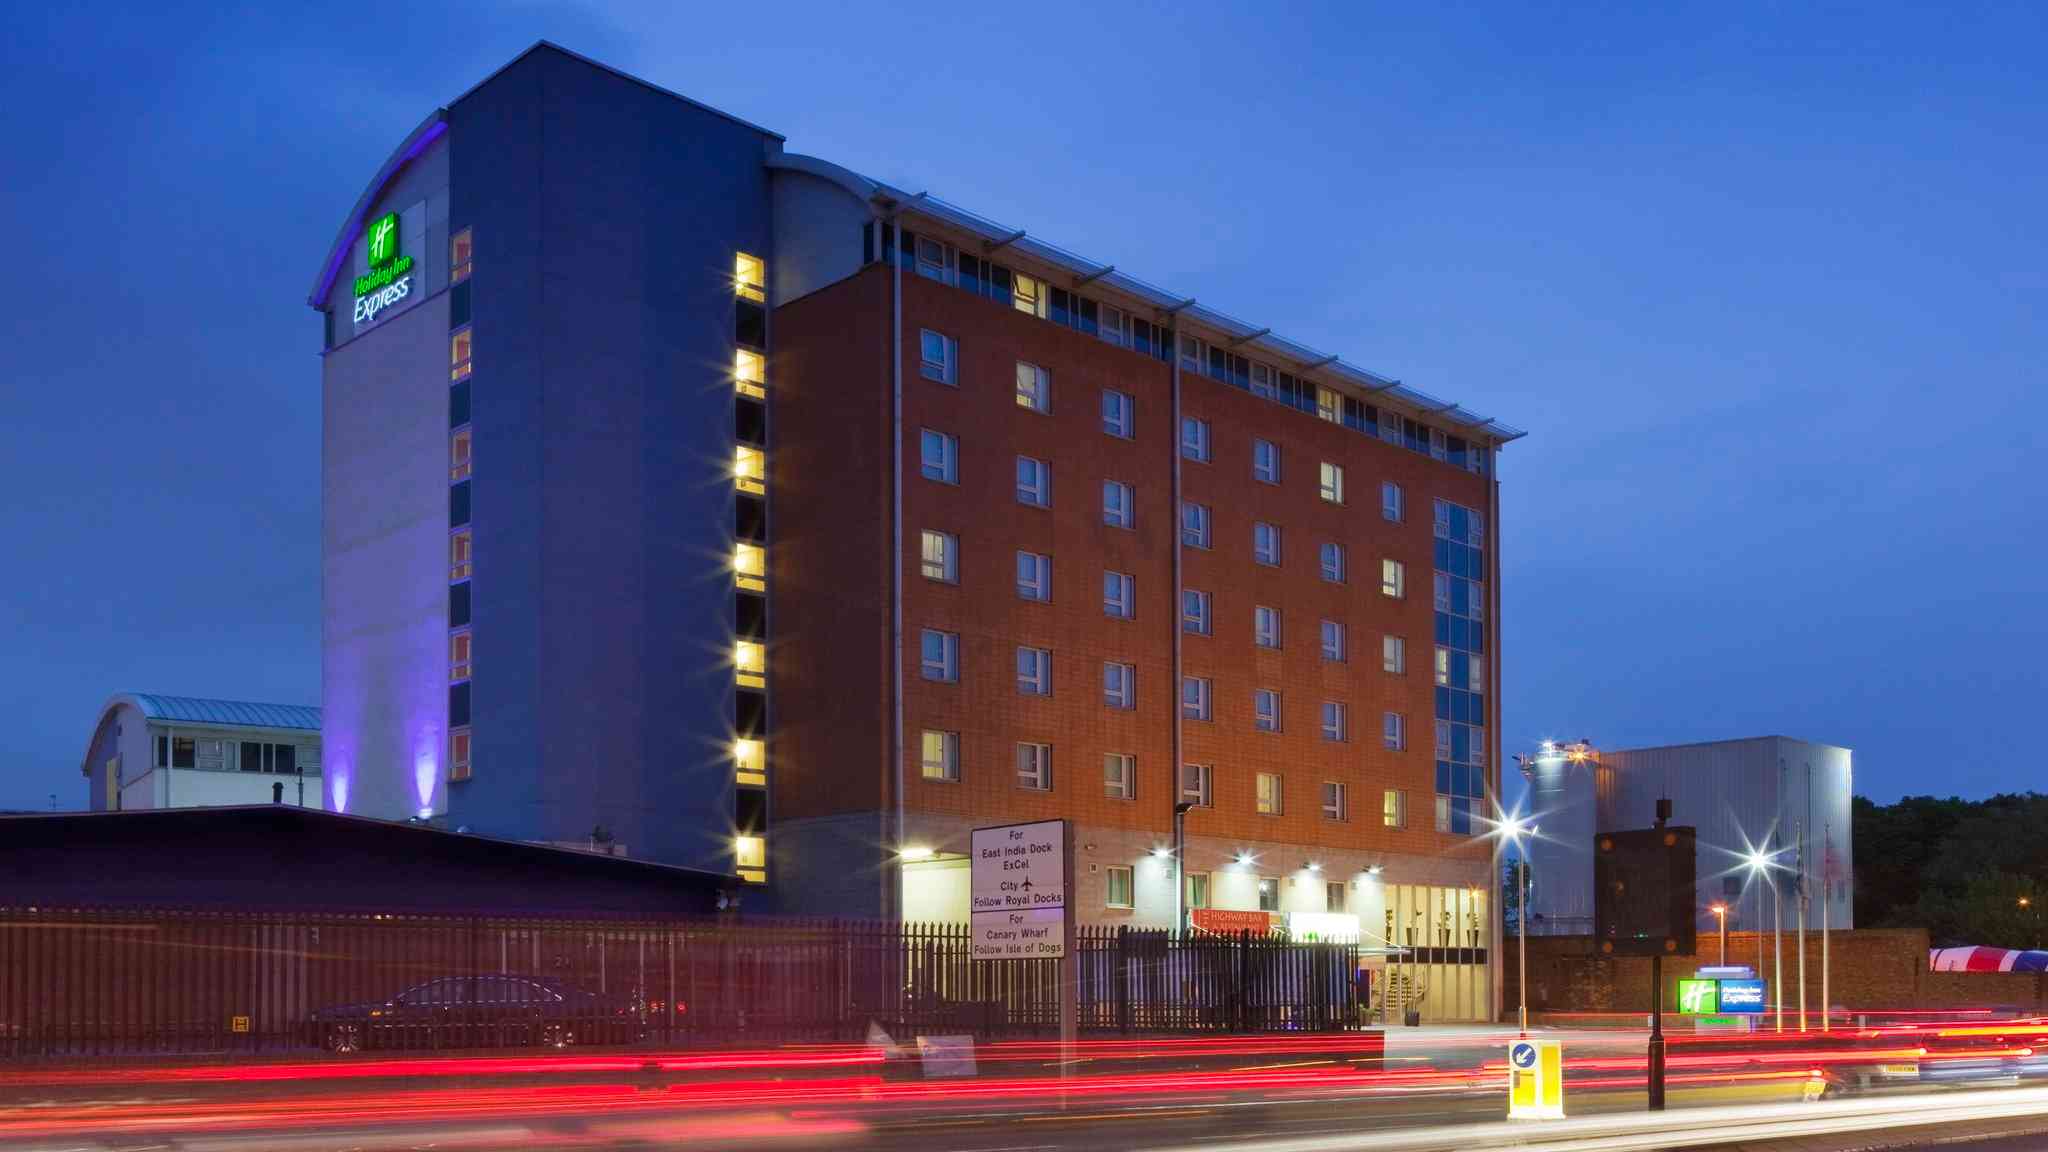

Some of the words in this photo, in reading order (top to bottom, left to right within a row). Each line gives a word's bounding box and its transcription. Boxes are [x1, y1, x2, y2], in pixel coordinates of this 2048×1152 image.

[355, 265, 392, 297] Holiday
[393, 255, 411, 274] Inn
[353, 276, 410, 323] Express
[1009, 830, 1024, 841] For
[982, 848, 1001, 859] East
[1004, 845, 1026, 857] India
[1030, 842, 1053, 853] Dock
[1003, 859, 1030, 871] ExCel
[1000, 880, 1019, 892] City
[974, 896, 1002, 907] Follow
[1006, 895, 1030, 906] Royal
[1034, 892, 1062, 904] Docks
[1009, 914, 1024, 924] For
[1211, 911, 1248, 921] HIGHWAY
[986, 930, 1017, 941] Canary
[1021, 927, 1049, 938] Wharf
[974, 944, 1002, 955] Follow
[1006, 943, 1022, 954] Isle
[1025, 942, 1035, 953] of
[1039, 942, 1062, 954] Dogs
